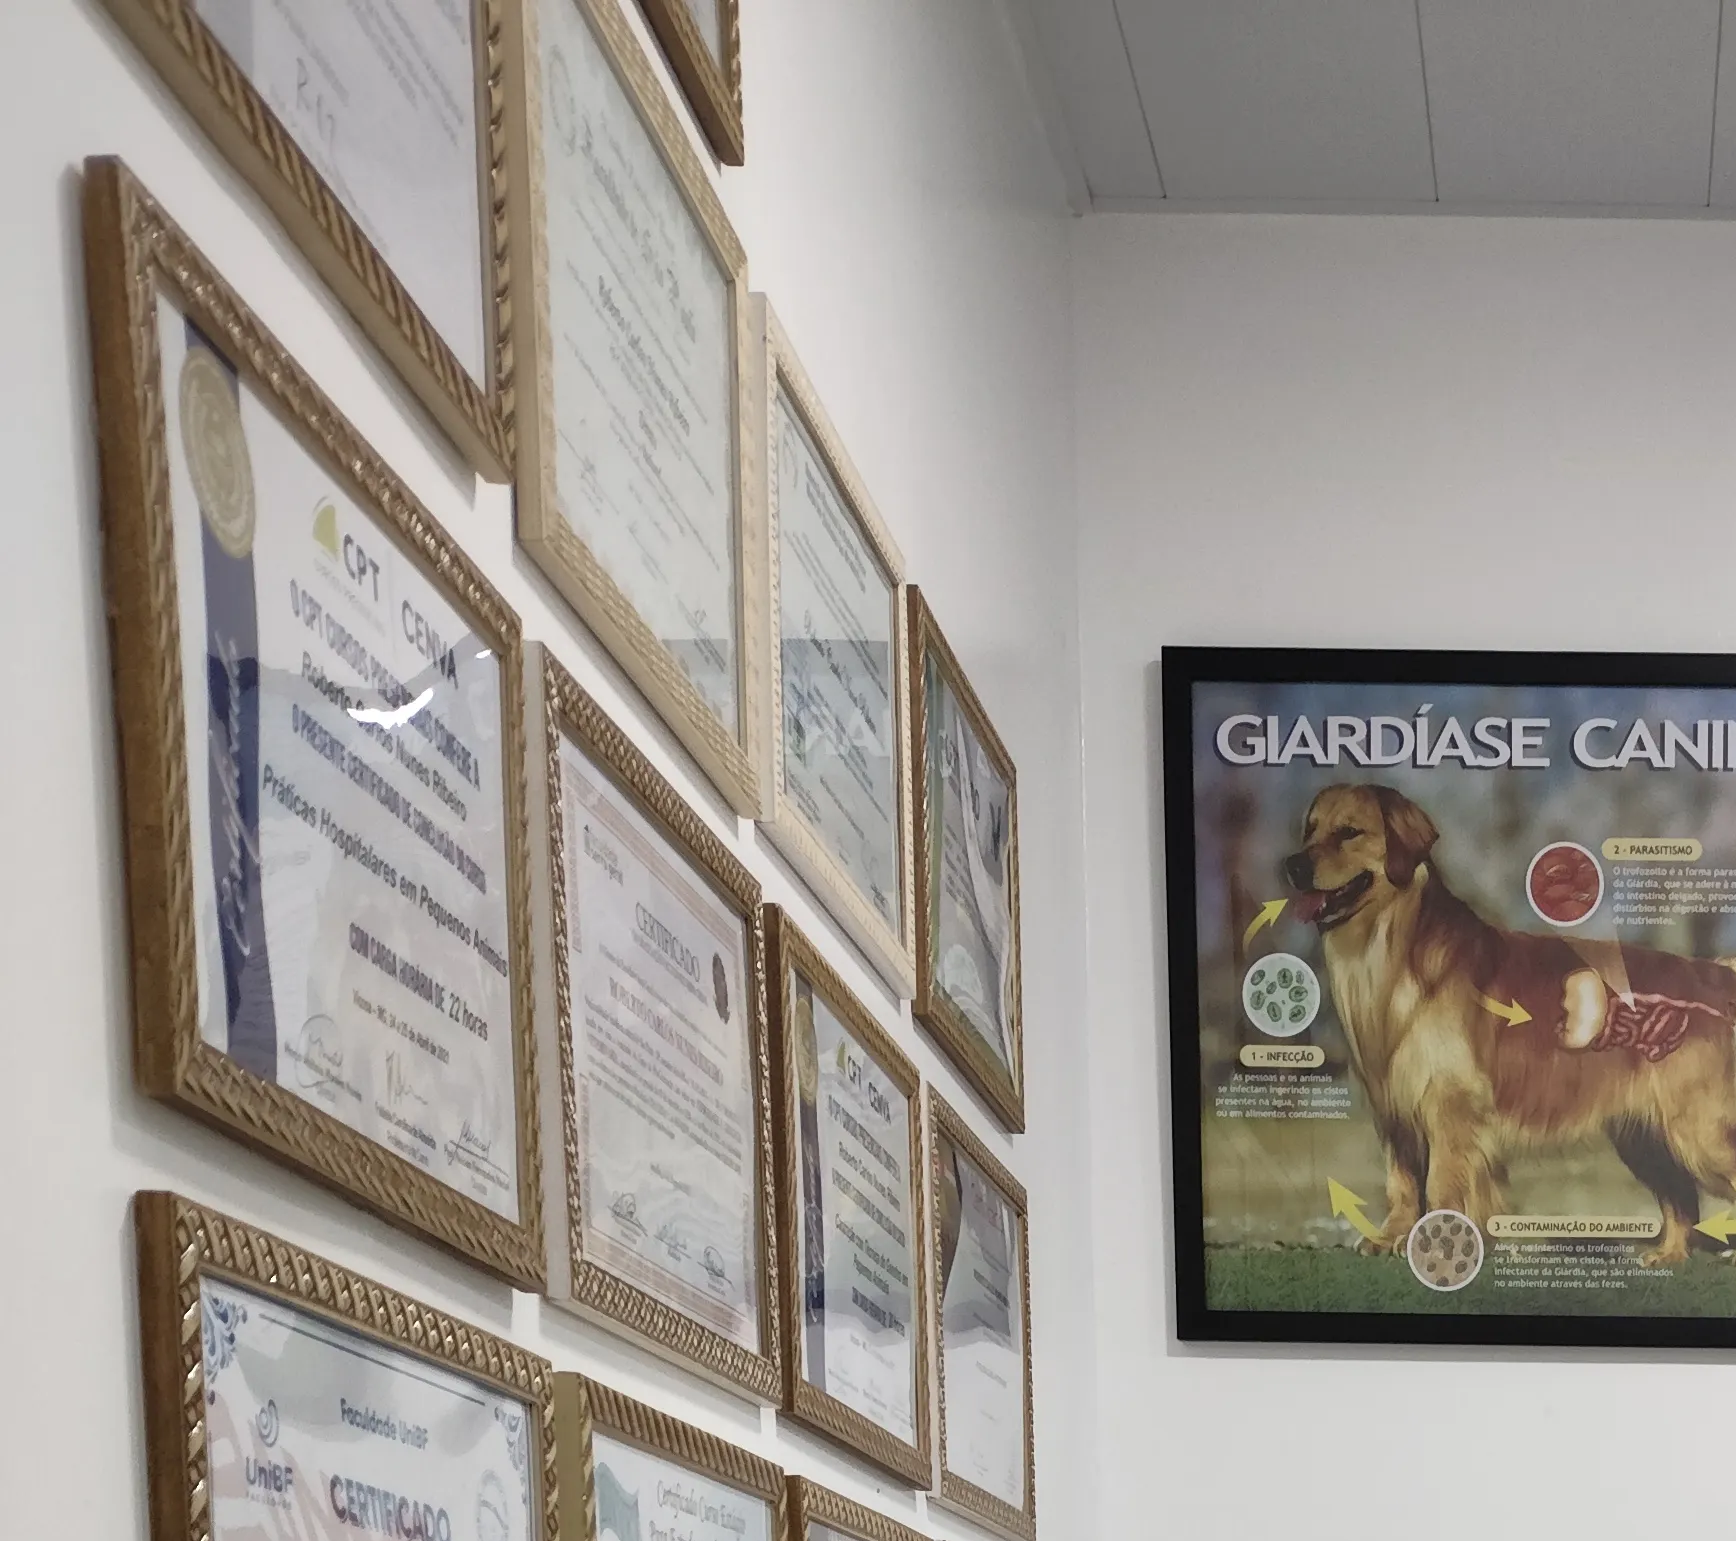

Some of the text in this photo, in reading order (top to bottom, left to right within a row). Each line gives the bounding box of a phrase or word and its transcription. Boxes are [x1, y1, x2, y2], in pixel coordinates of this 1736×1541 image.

[342, 531, 381, 608] CPT
[1216, 703, 1550, 768] GIARDÍASE
[1614, 845, 1693, 855] 2 PARASITISMO
[261, 761, 507, 980] Práticas Hospitalares em Pequenos Animais
[634, 902, 701, 982] CERTIFICADO
[448, 991, 488, 1042] 22 horas
[1267, 1052, 1314, 1063] INFECÇÃO
[1245, 1074, 1277, 1083] pessoas
[1300, 1074, 1332, 1082] animais
[1230, 1085, 1267, 1093] infectam
[1270, 1085, 1310, 1096] ingerindo
[1324, 1086, 1348, 1095] cistos
[1245, 1109, 1286, 1118] alimentos
[1288, 1111, 1350, 1120] contaminados.
[1495, 1221, 1653, 1234] 3 CONTAMINAÇÃO DO AMBIENTE
[1507, 1255, 1561, 1264] transformam
[1580, 1256, 1607, 1265] cistos,
[1618, 1256, 1643, 1265] forma
[1495, 1267, 1673, 1278] infectante da Giárdia, que são eliminados
[1508, 1279, 1548, 1288] ambiente
[1551, 1279, 1583, 1288] através
[1585, 1280, 1599, 1289] das
[1602, 1280, 1628, 1289] fezes.
[246, 1456, 293, 1493] UniBF
